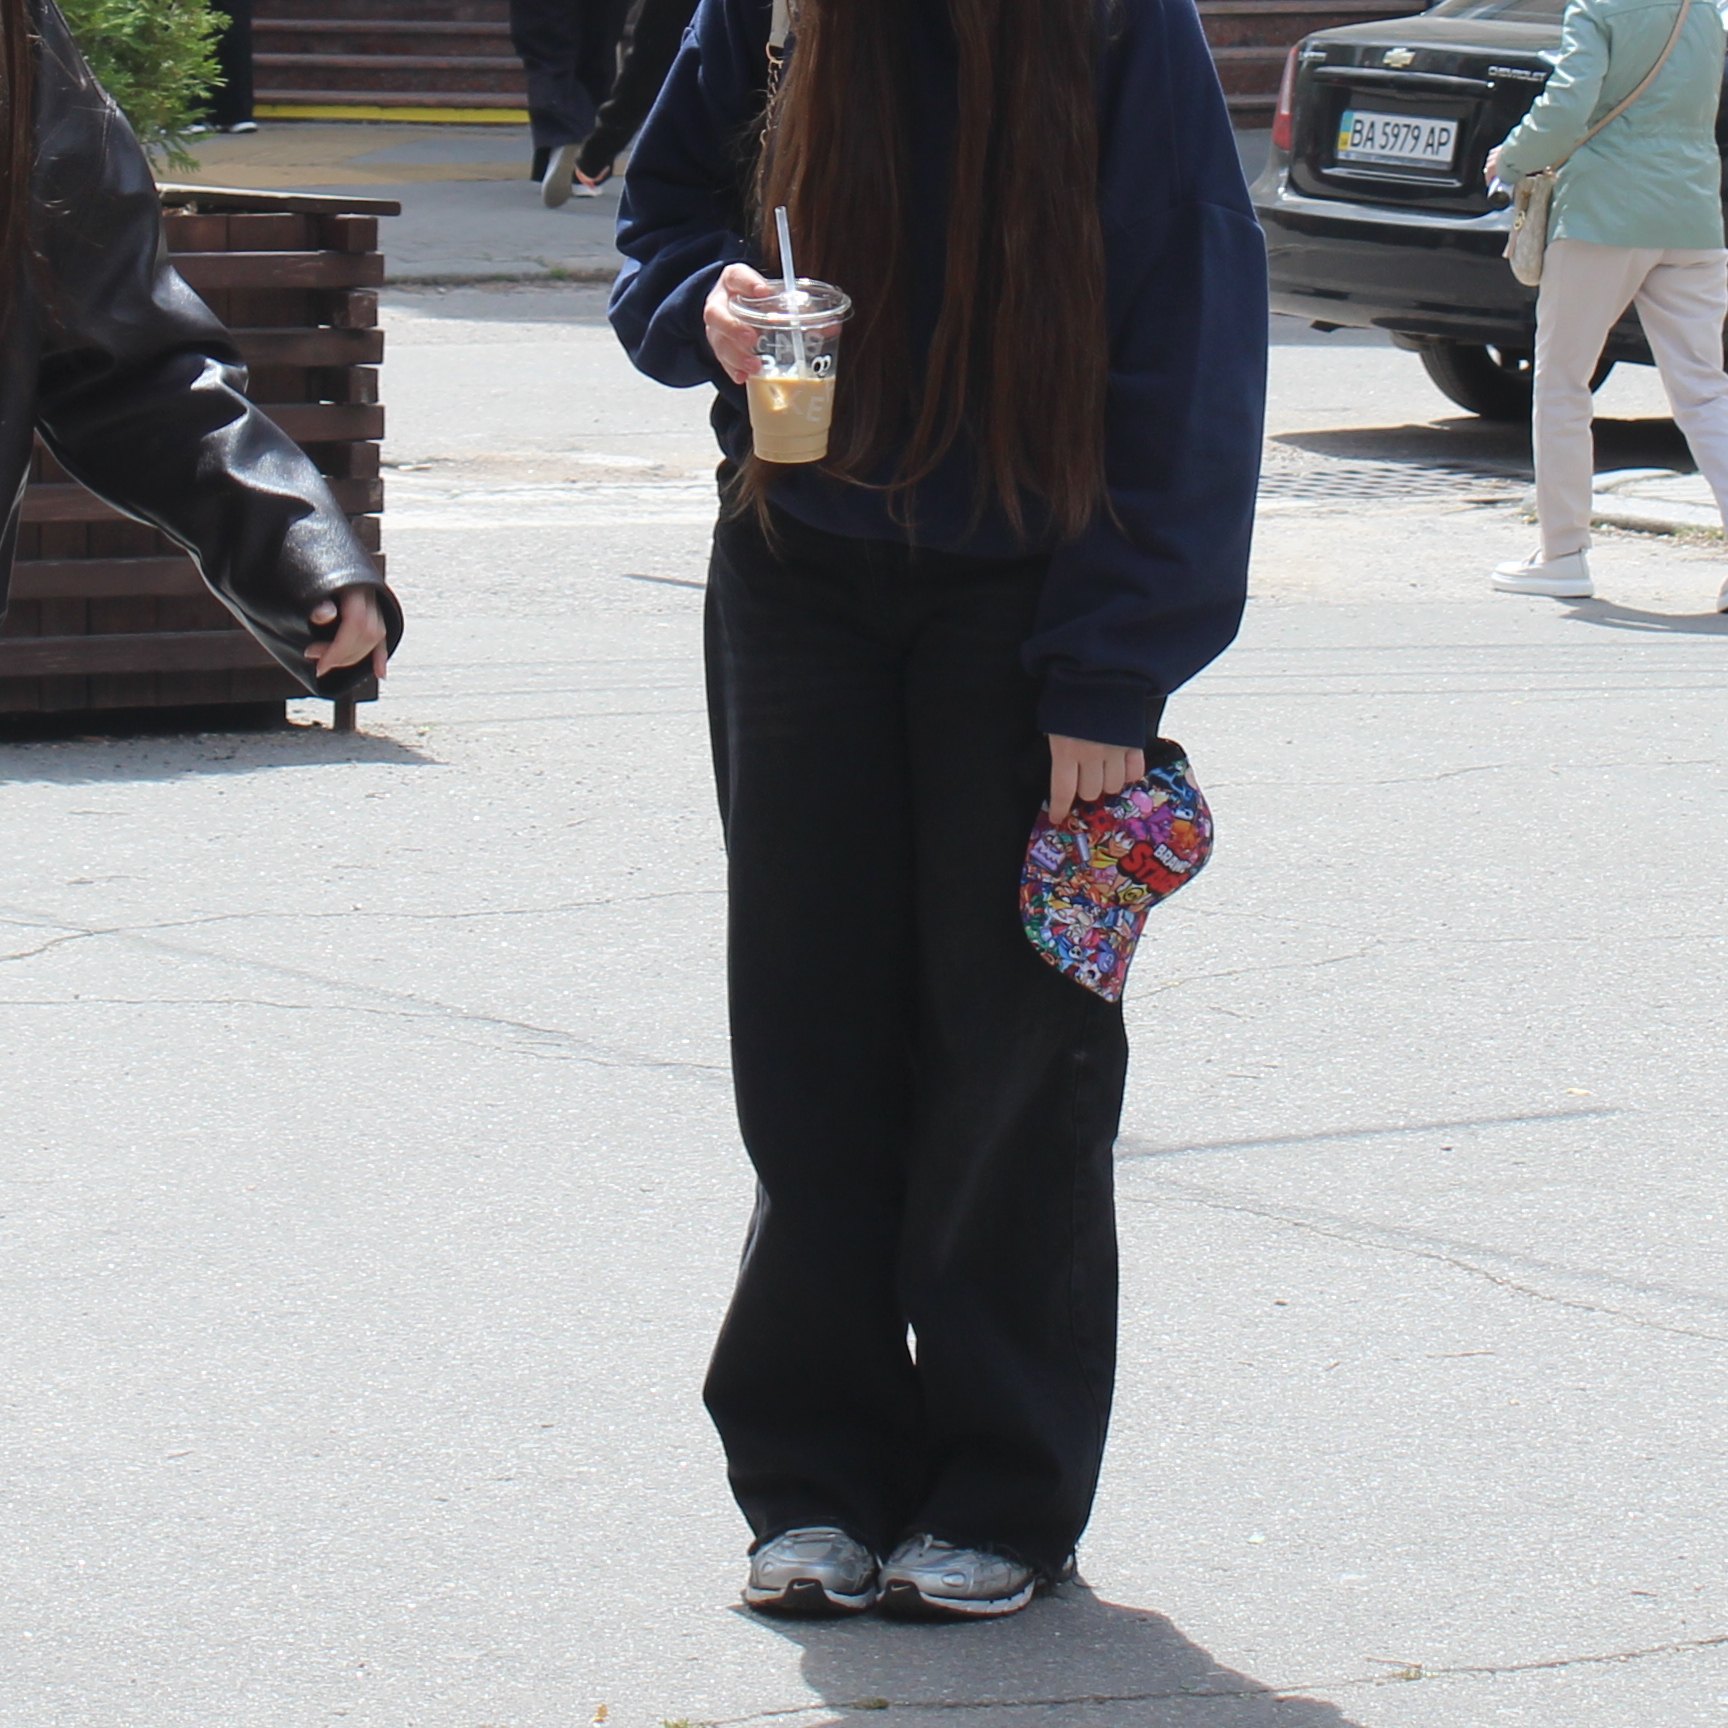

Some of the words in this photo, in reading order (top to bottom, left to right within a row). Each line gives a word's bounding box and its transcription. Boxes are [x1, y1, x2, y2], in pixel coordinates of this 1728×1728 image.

[1349, 119, 1376, 150] BA
[1378, 121, 1421, 153] 5979
[1422, 126, 1451, 156] AP
